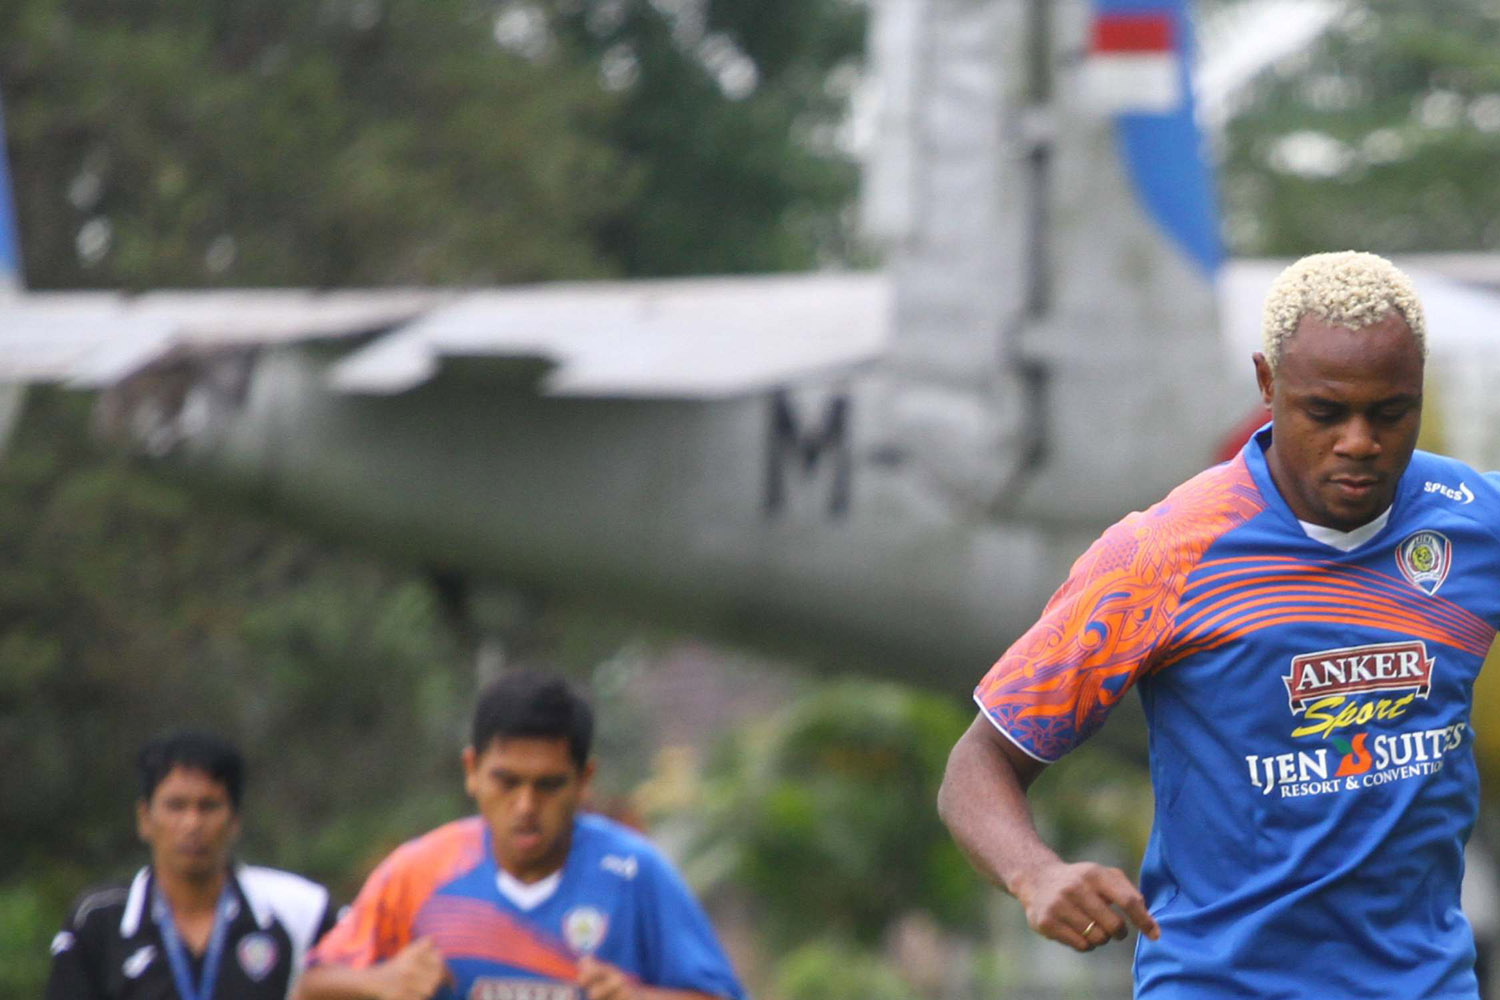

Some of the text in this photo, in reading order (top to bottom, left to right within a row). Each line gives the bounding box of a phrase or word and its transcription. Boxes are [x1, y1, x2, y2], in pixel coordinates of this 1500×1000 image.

[1423, 481, 1463, 501] SPECS
[1296, 651, 1424, 691] ANKER
[1291, 693, 1415, 740] Sport
[1245, 749, 1328, 795] IJEN
[1281, 779, 1341, 798] RESORT
[1345, 775, 1360, 791] &
